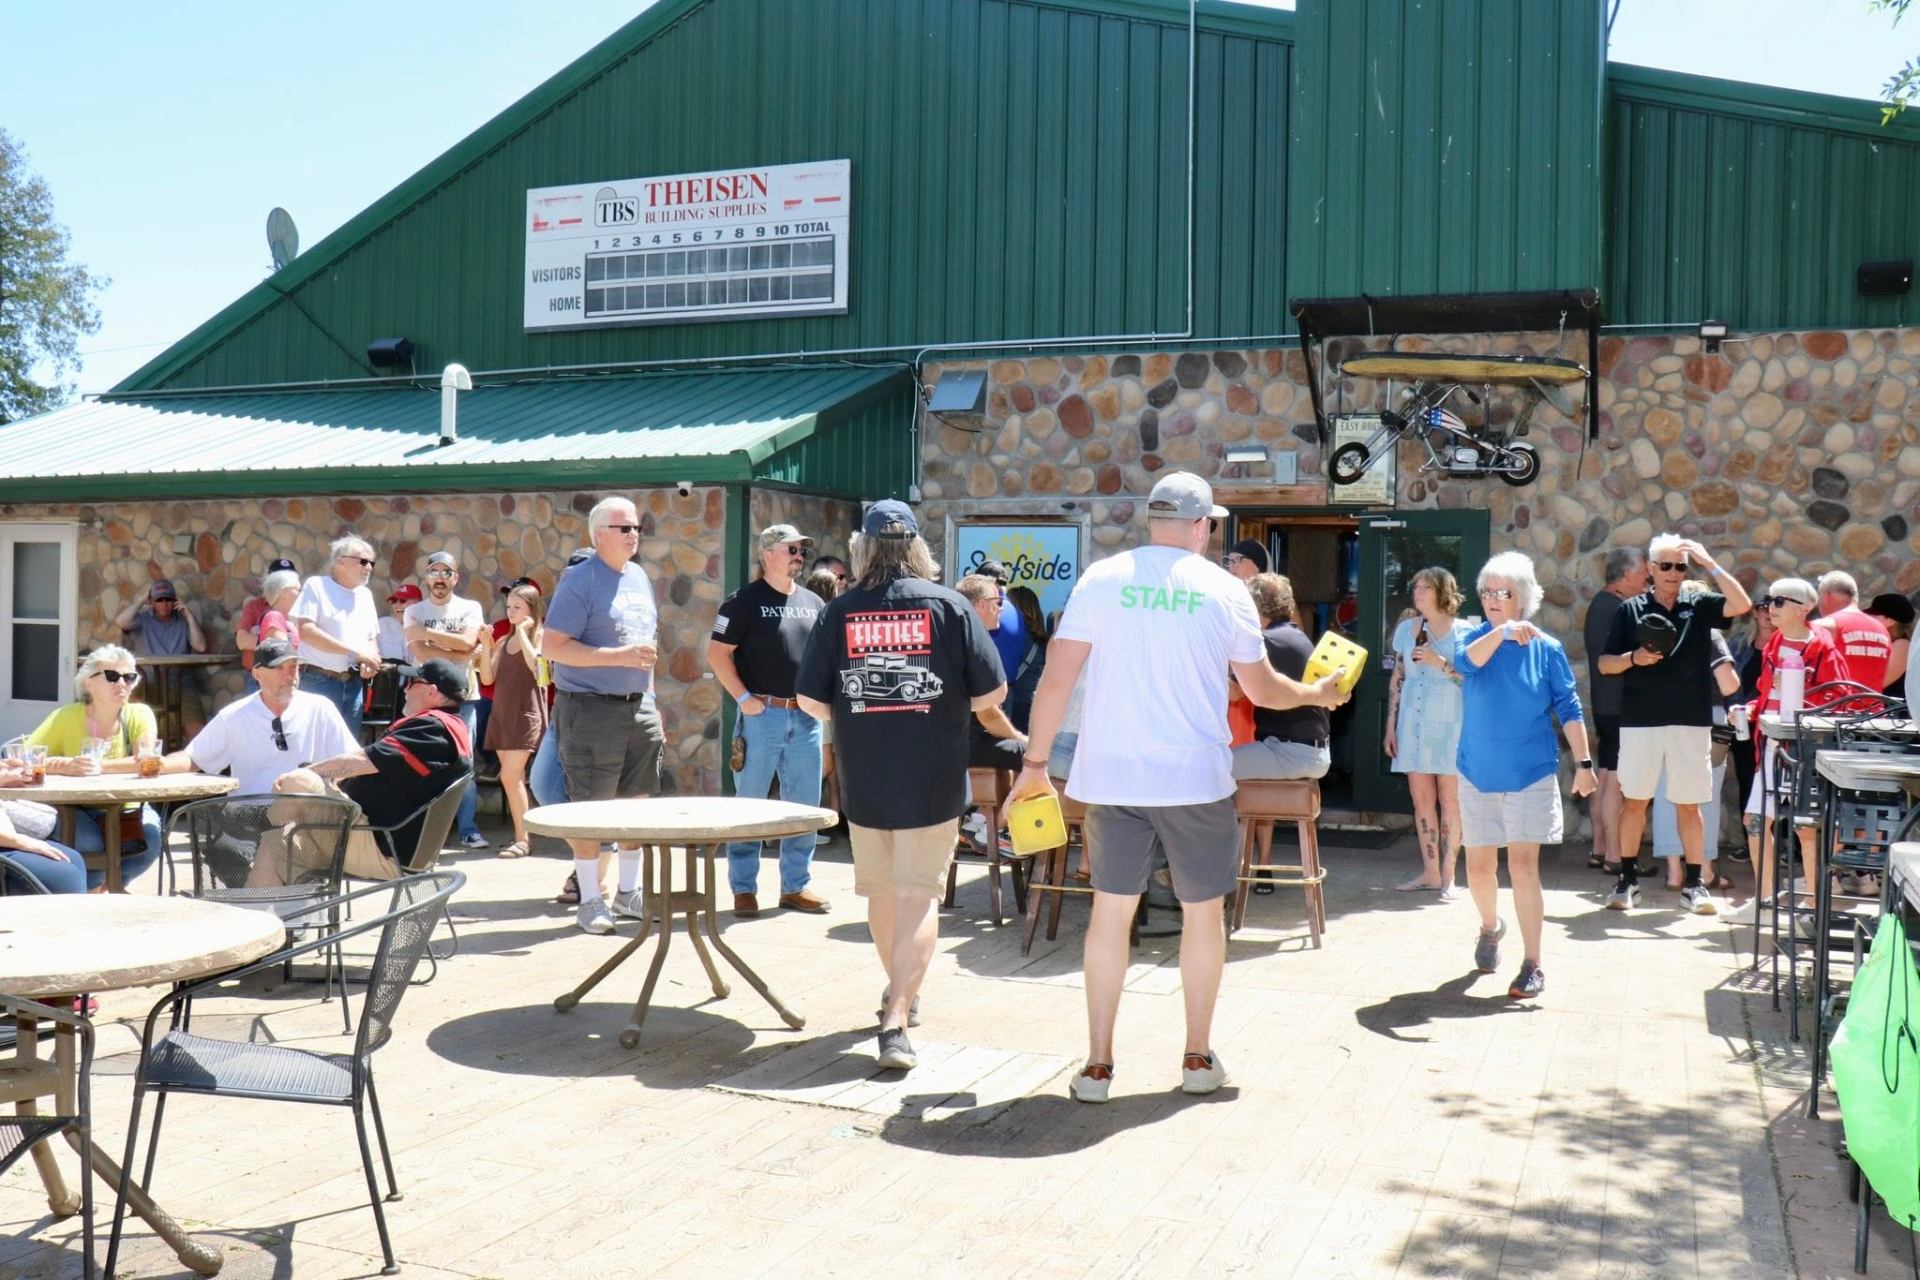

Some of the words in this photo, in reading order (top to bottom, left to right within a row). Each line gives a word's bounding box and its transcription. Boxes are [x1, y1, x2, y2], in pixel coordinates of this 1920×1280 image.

[644, 172, 768, 207] THEISEN
[599, 200, 635, 223] TBS
[645, 208, 704, 224] BUILDING
[708, 202, 767, 219] SUPPLIES
[594, 239, 600, 249] 1
[611, 237, 621, 248] 2
[632, 236, 641, 247] 3
[652, 234, 661, 245] 4
[672, 233, 682, 244] 5
[693, 231, 703, 242] 6
[714, 230, 723, 240] 7
[734, 227, 744, 239] 8
[756, 226, 766, 237] 9
[774, 225, 789, 236] 10
[794, 221, 831, 234] TOTAL
[532, 266, 581, 283] VISITORS
[549, 296, 581, 312] HOME
[1340, 421, 1359, 432] EASY
[963, 550, 1072, 584] Srfside
[1120, 584, 1205, 615] STAFF
[760, 605, 817, 619] PATRIOT
[854, 614, 880, 622] BACK
[858, 645, 923, 653] WEEKEND
